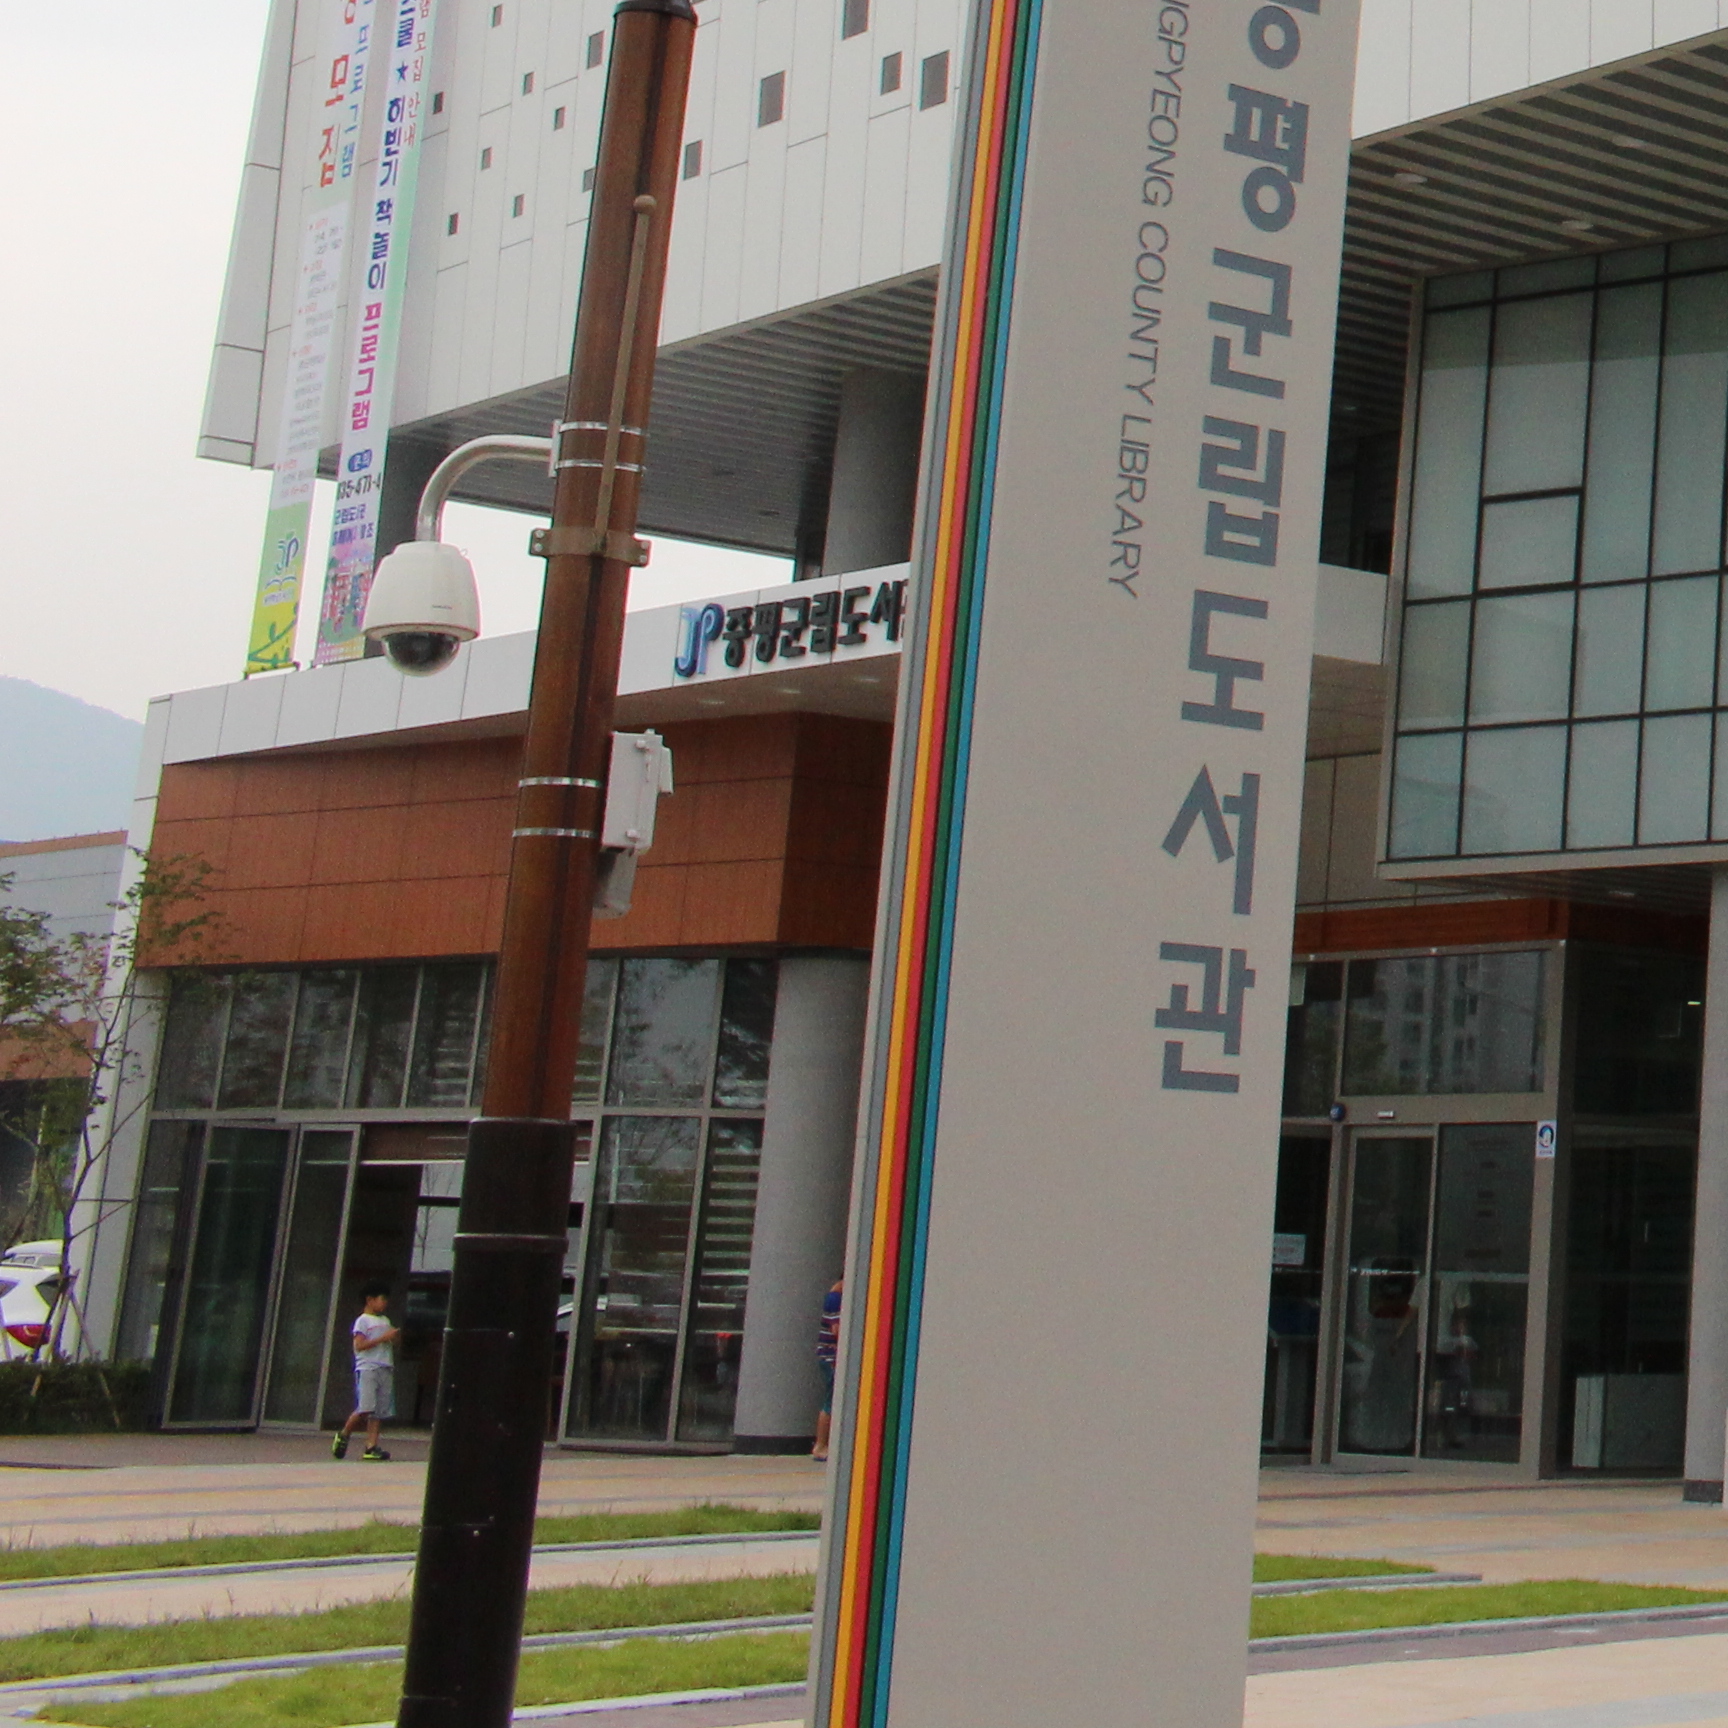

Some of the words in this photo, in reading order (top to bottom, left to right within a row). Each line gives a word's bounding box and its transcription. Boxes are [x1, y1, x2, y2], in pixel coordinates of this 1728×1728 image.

[318, 54, 350, 188] 모집
[342, 24, 370, 178] 프로그램
[413, 32, 427, 83] 모집
[351, 302, 382, 431] 프로그램
[1125, 220, 1170, 406] COUNTY
[1108, 411, 1153, 600] LIBRARY
[723, 579, 909, 668] 증평군립도서
